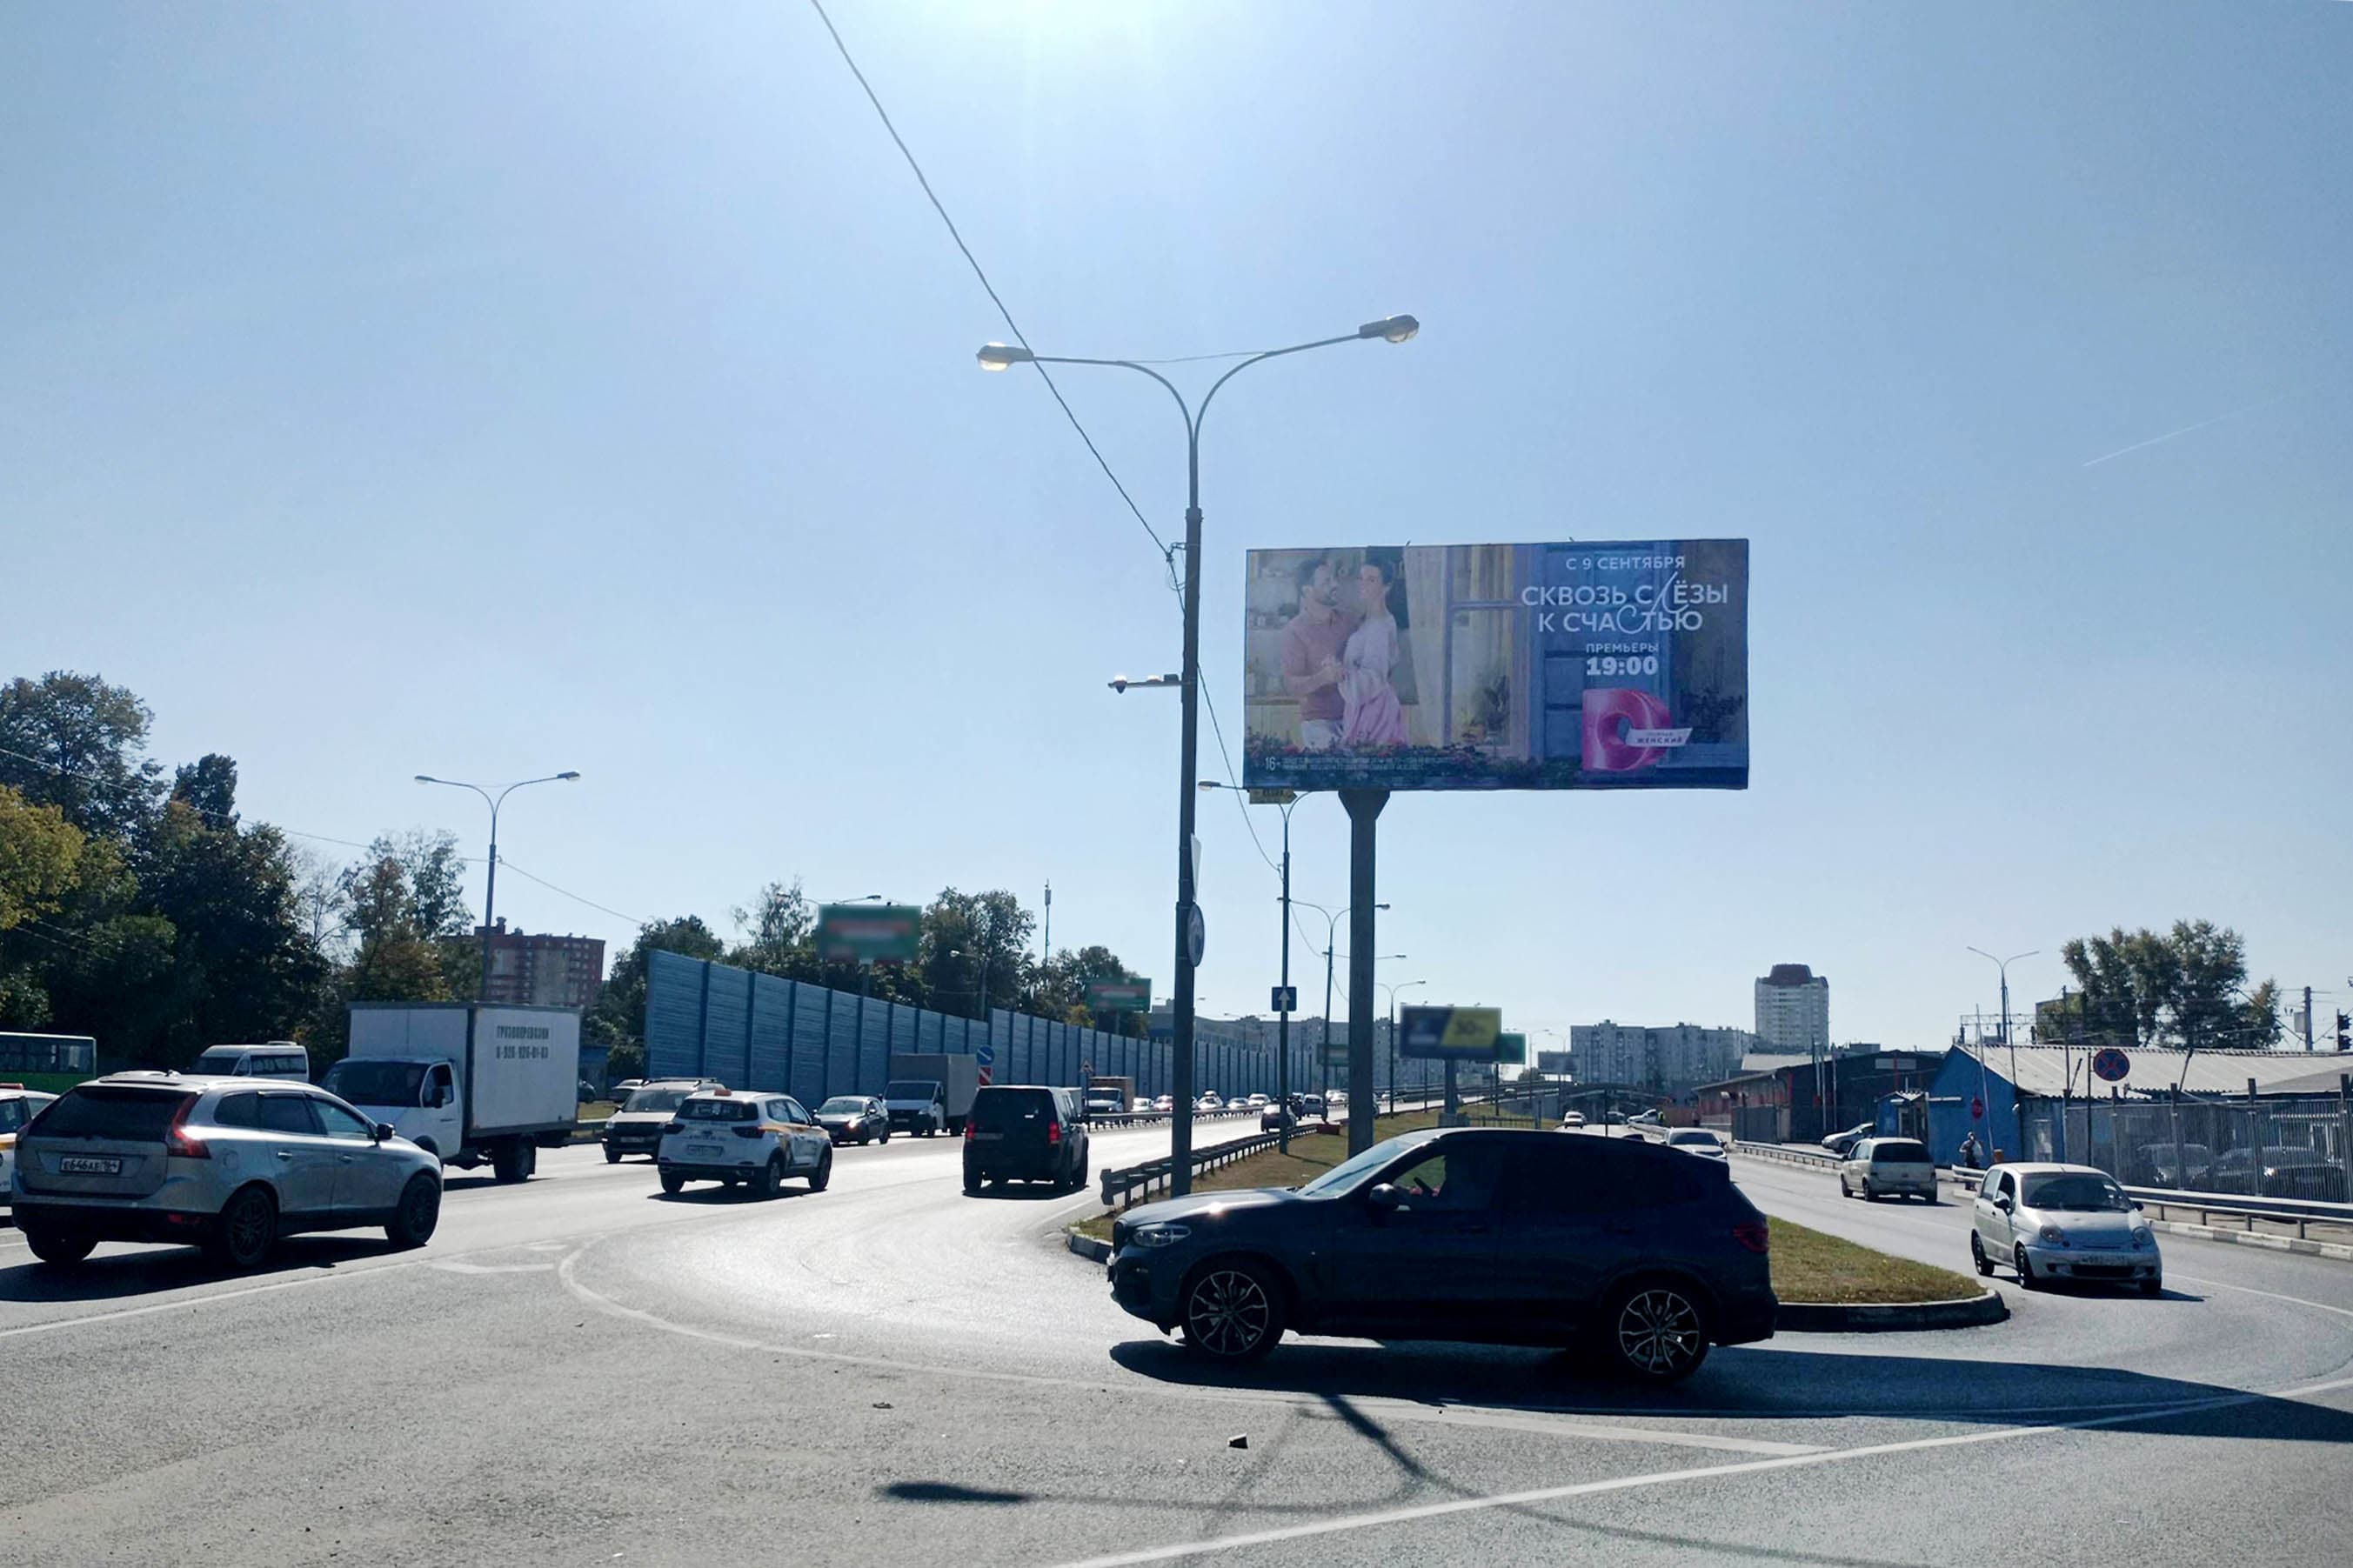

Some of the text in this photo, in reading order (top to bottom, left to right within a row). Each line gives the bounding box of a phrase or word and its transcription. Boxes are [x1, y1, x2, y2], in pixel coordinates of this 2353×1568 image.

[1566, 556, 1686, 570] С 9 СЕНТЯБРЯ
[1521, 571, 1728, 614] СКВОЗЬ СЛЁЗЫ
[1538, 604, 1703, 634] К СЧАСТЬЮ
[1586, 643, 1660, 653] ПРЕМЬЕРЫ
[1586, 656, 1659, 676] 19:00
